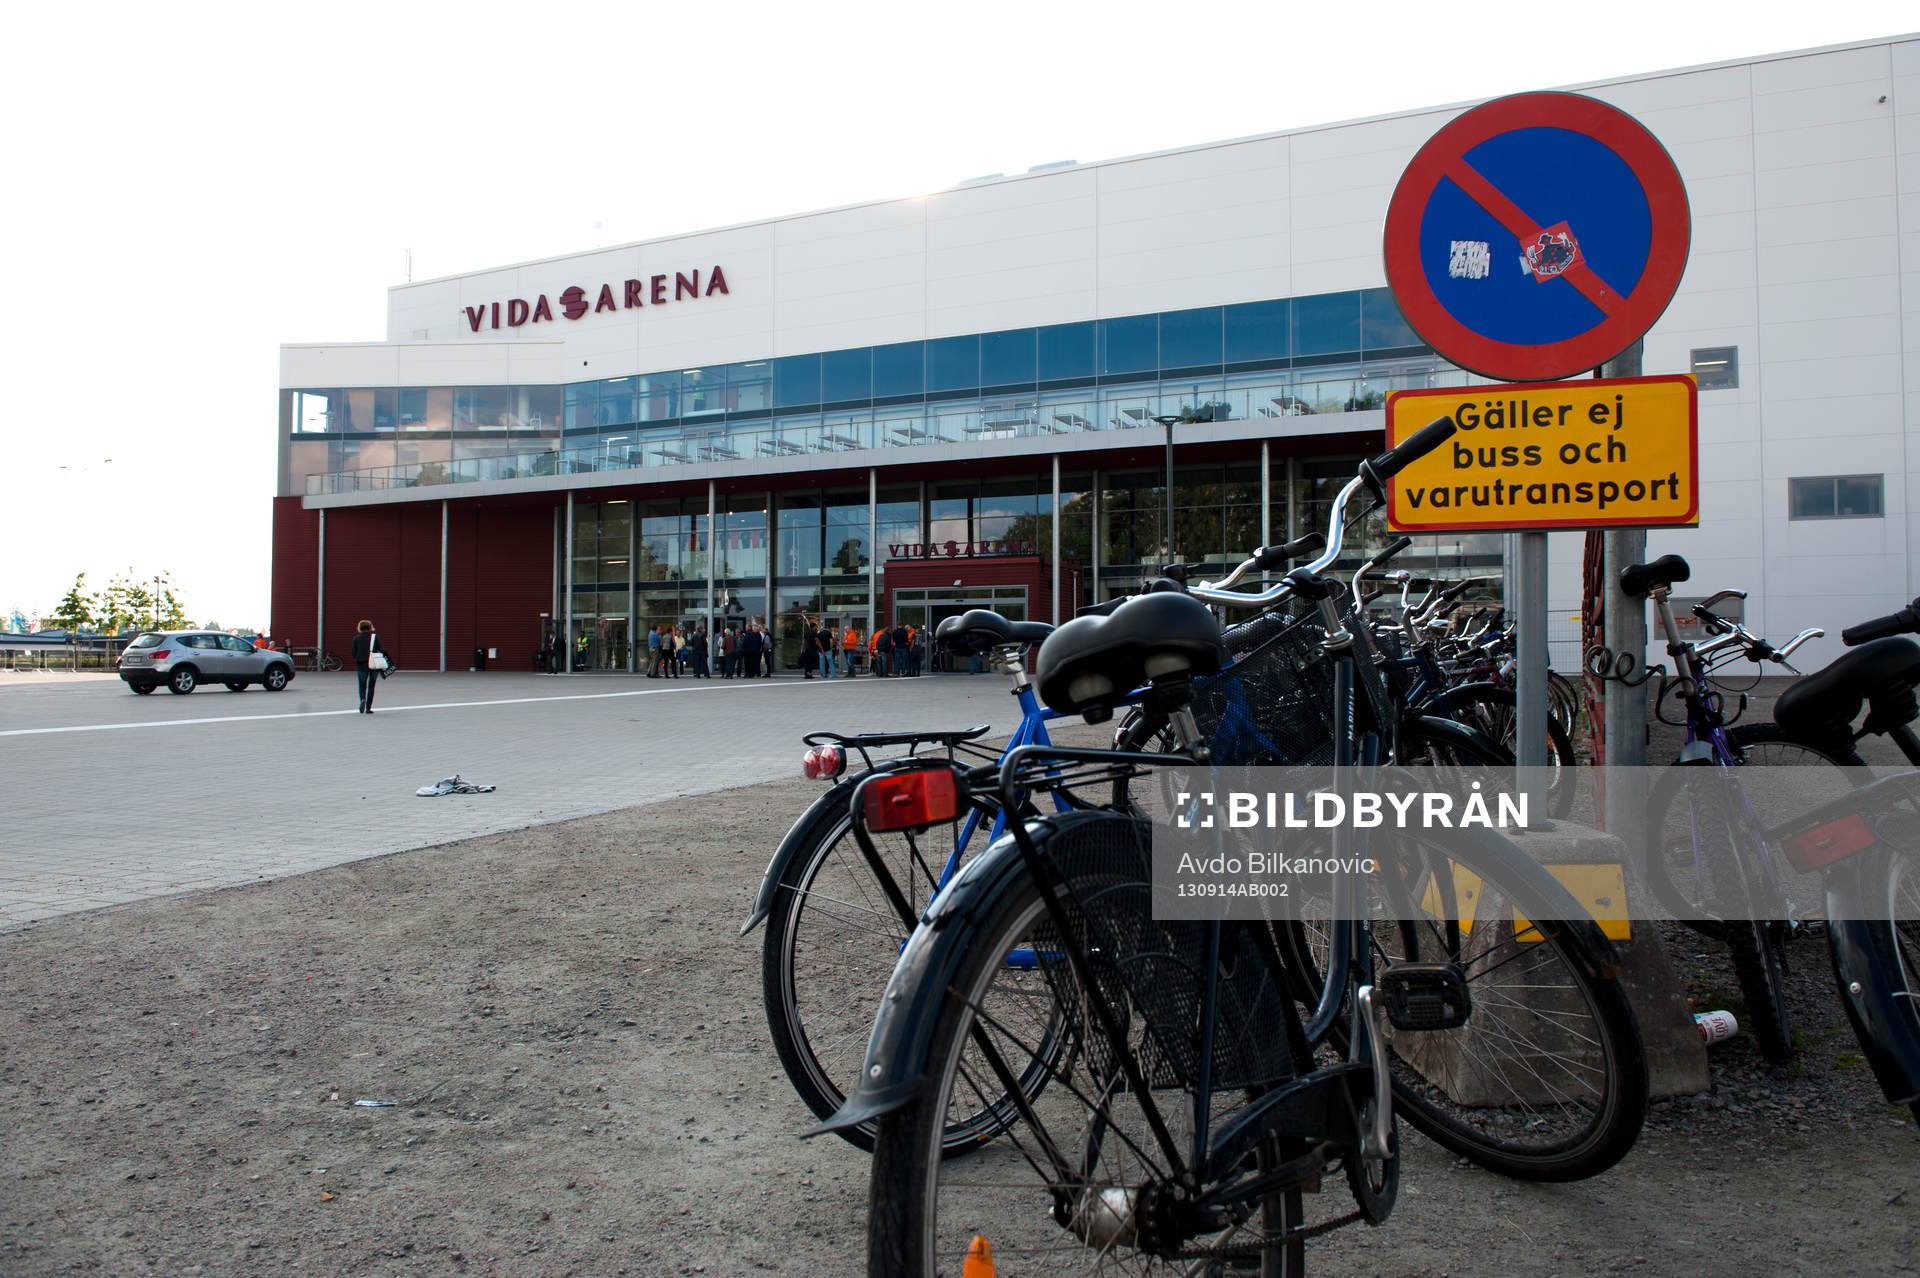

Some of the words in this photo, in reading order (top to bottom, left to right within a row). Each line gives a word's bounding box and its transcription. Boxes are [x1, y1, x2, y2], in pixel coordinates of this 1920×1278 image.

[466, 294, 553, 332] VIDA
[595, 265, 729, 313] ARENA
[1455, 399, 1573, 431] Gäller
[1588, 394, 1624, 430] ej
[1453, 441, 1542, 469] buss
[1559, 435, 1626, 465] och
[1405, 472, 1679, 509] varutransport
[888, 543, 940, 558] VIDA
